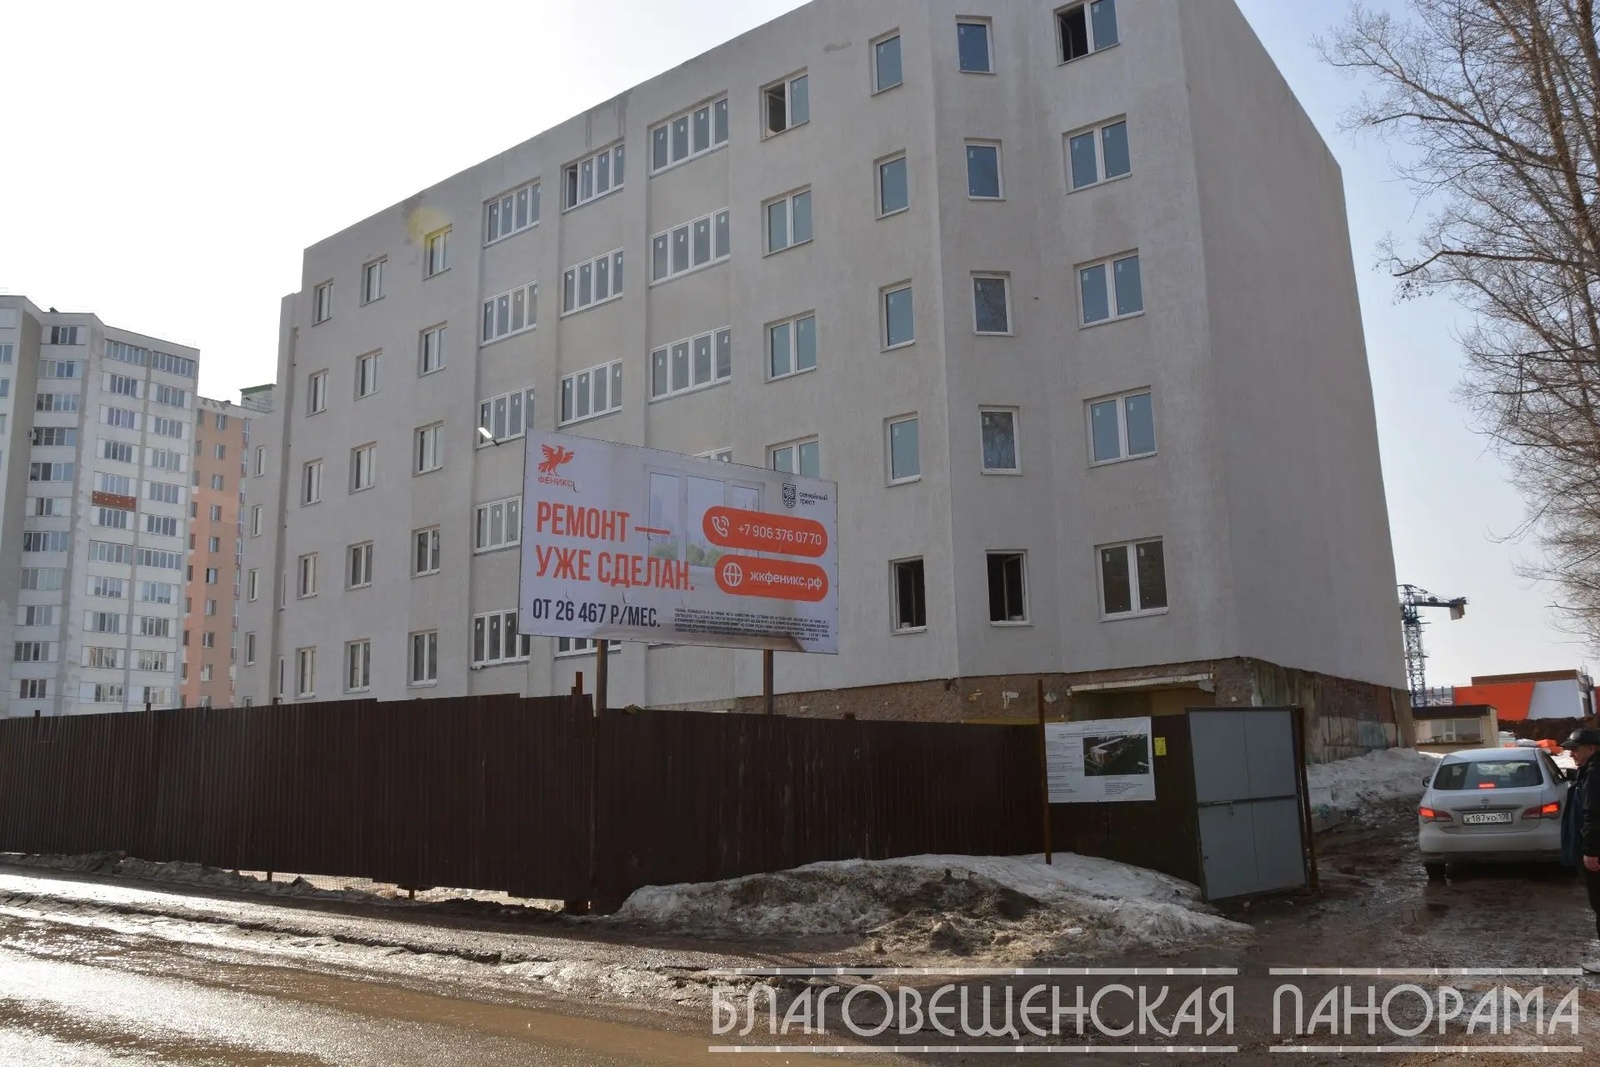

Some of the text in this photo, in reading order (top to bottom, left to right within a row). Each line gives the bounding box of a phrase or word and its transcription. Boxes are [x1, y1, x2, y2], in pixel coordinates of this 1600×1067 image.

[538, 476, 573, 488] ФЕНИКС
[536, 501, 630, 543] РЕМОНТ
[738, 525, 822, 546] +7 906 376 07 70
[535, 544, 695, 591] УЖЕ СДЕЛАН.
[750, 571, 822, 590] жкфеникс.рф
[532, 598, 553, 620] ОТ
[555, 600, 574, 622] 26
[578, 602, 607, 623] 467
[610, 604, 661, 628] Р/МЕС.
